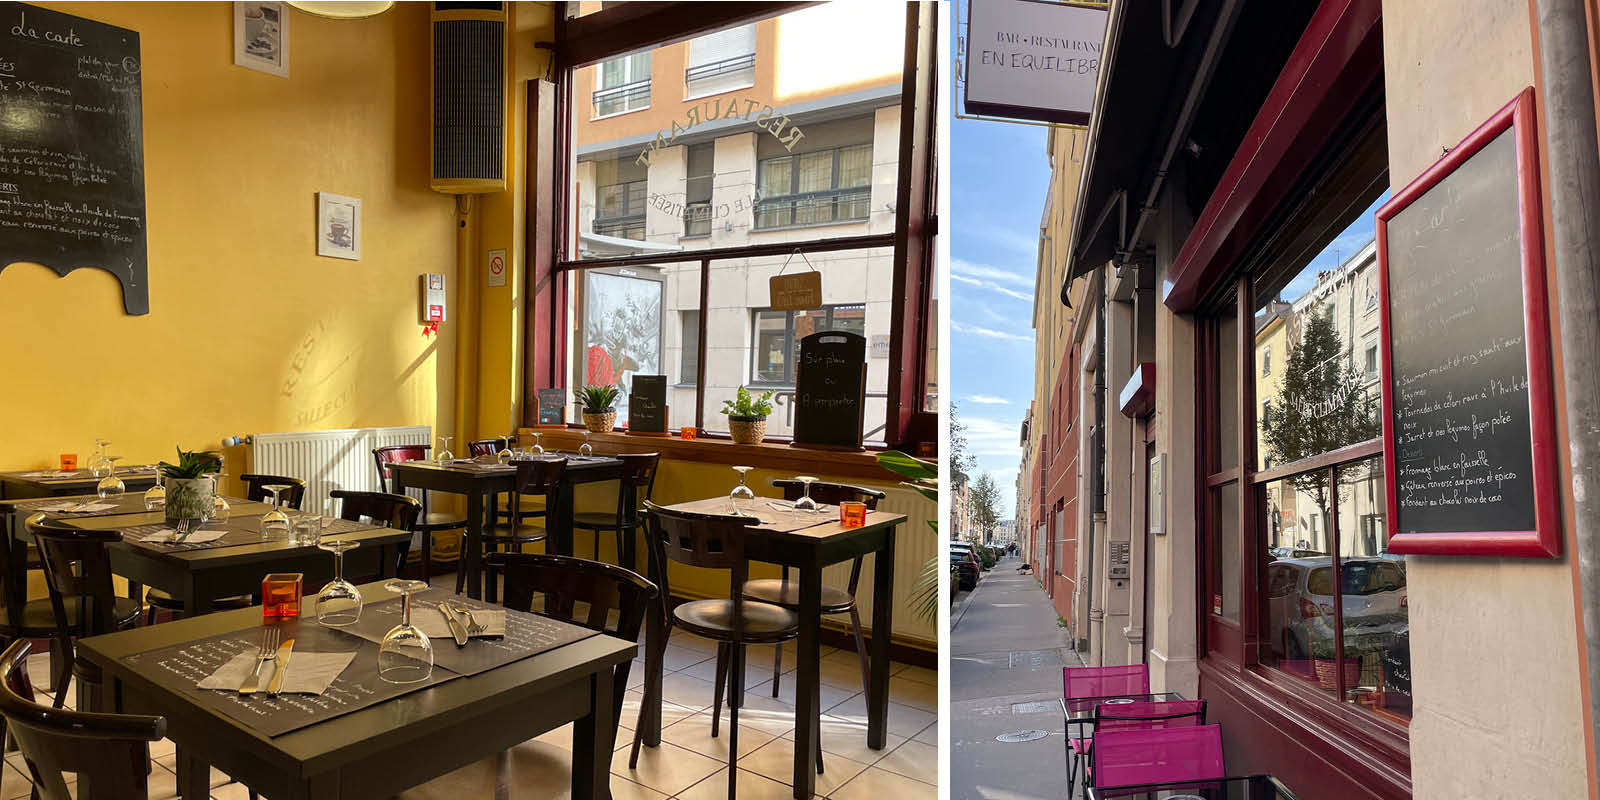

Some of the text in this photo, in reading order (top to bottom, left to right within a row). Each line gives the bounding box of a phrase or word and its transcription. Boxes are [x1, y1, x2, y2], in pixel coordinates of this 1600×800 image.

[11, 11, 84, 47] La carte
[997, 31, 1020, 44] BAR
[982, 50, 1005, 67] EN
